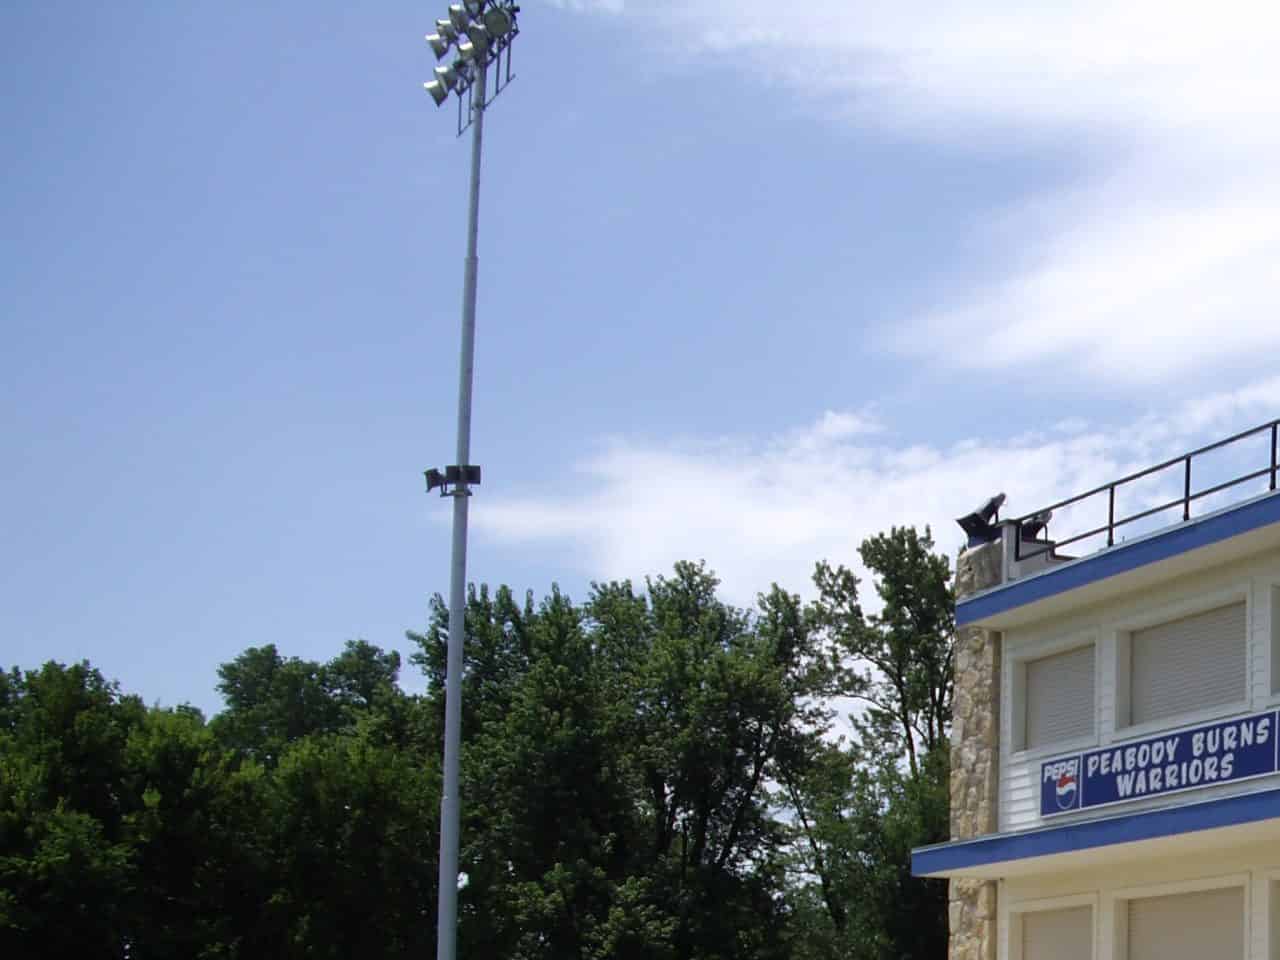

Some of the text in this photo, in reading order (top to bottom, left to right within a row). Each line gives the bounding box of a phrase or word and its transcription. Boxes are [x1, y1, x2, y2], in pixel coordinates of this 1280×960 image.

[1087, 718, 1270, 777] PEABODY BURNS
[1043, 759, 1079, 783] PEPSI
[1116, 754, 1234, 797] WARRIORS
